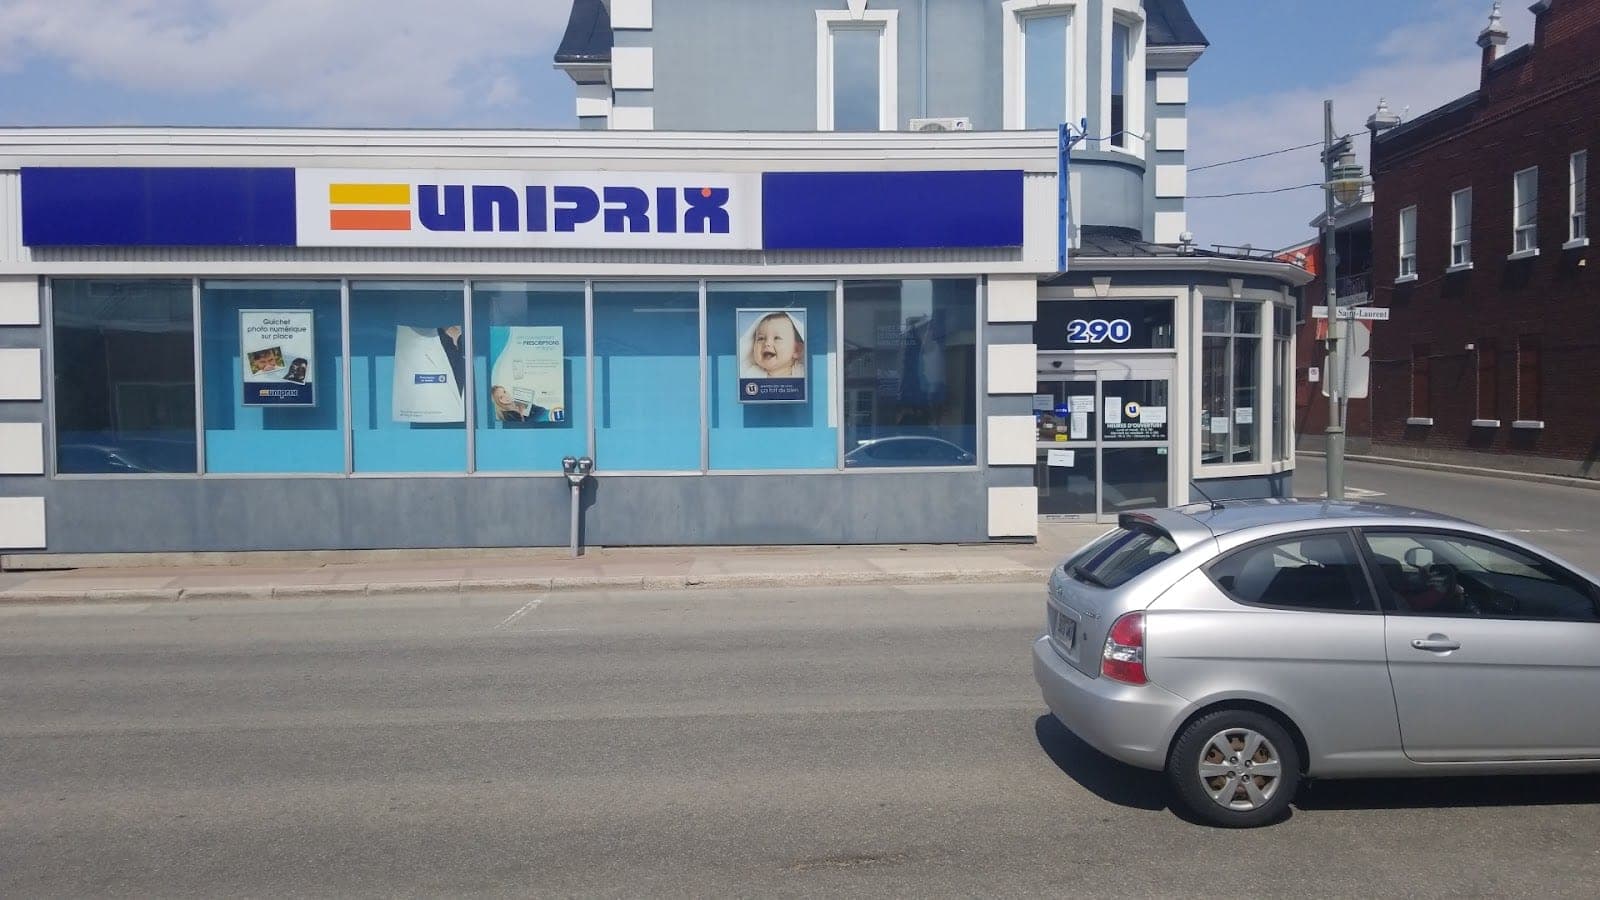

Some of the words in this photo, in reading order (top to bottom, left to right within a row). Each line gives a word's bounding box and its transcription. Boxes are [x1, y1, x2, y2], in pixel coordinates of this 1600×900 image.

[418, 184, 730, 233] UNIPRIX
[1337, 309, 1387, 318] Saint-Laurent
[270, 325, 307, 334] numérique
[1066, 319, 1131, 343] 290
